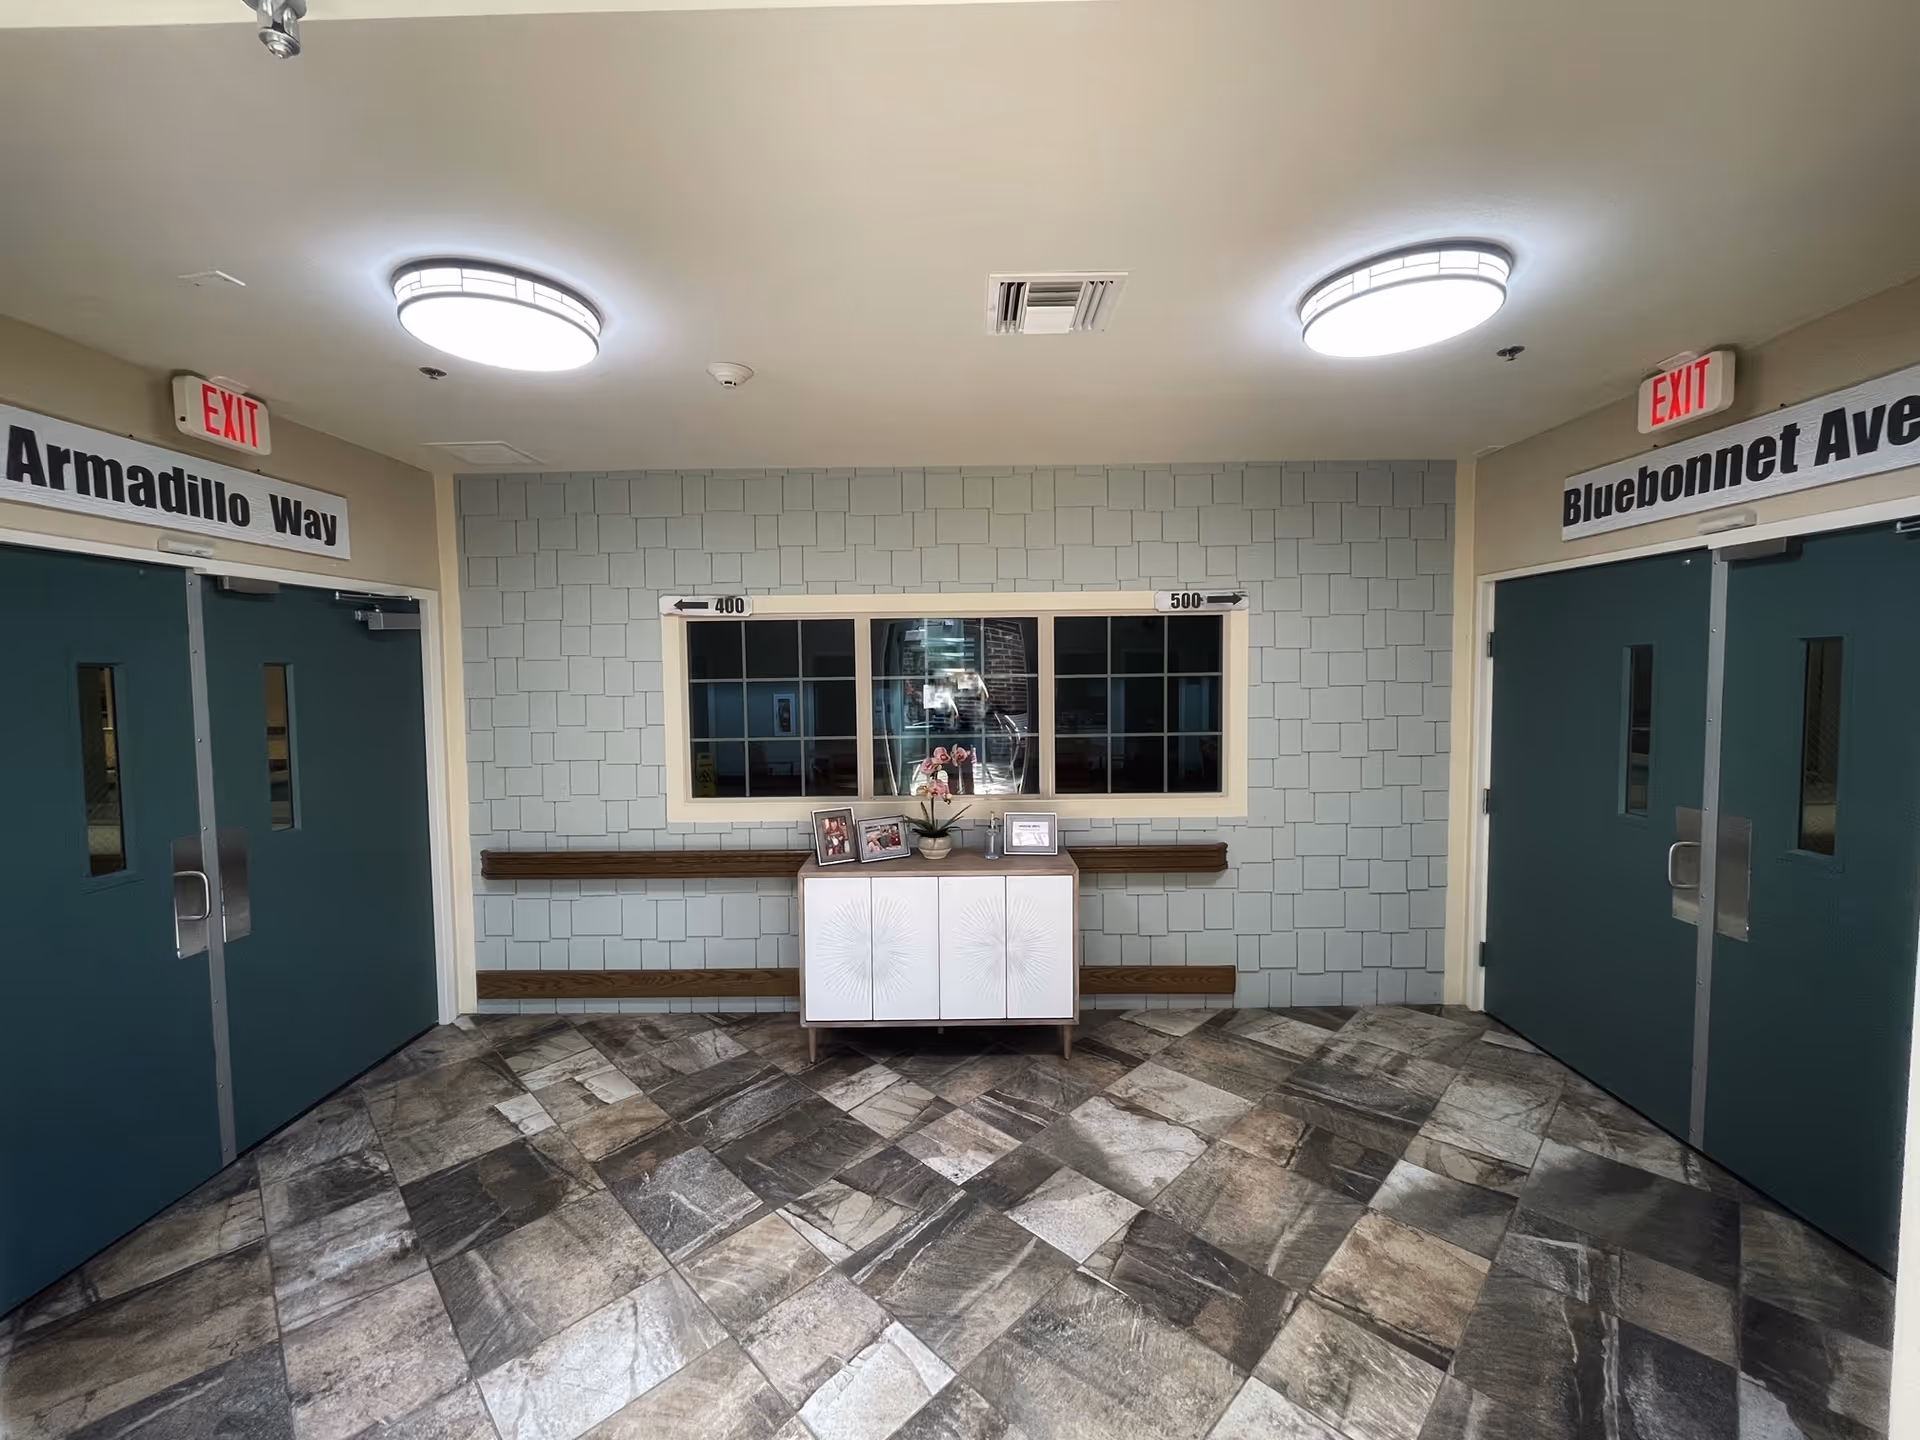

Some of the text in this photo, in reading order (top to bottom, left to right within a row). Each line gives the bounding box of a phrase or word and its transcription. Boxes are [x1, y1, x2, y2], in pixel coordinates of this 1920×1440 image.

[201, 383, 259, 448] EXIT
[1651, 357, 1711, 426] EXIT
[6, 424, 337, 547] Armadillo Way
[1562, 394, 1920, 528] Bluebonnet Ave
[714, 597, 745, 614] 400
[1170, 592, 1201, 609] 500
